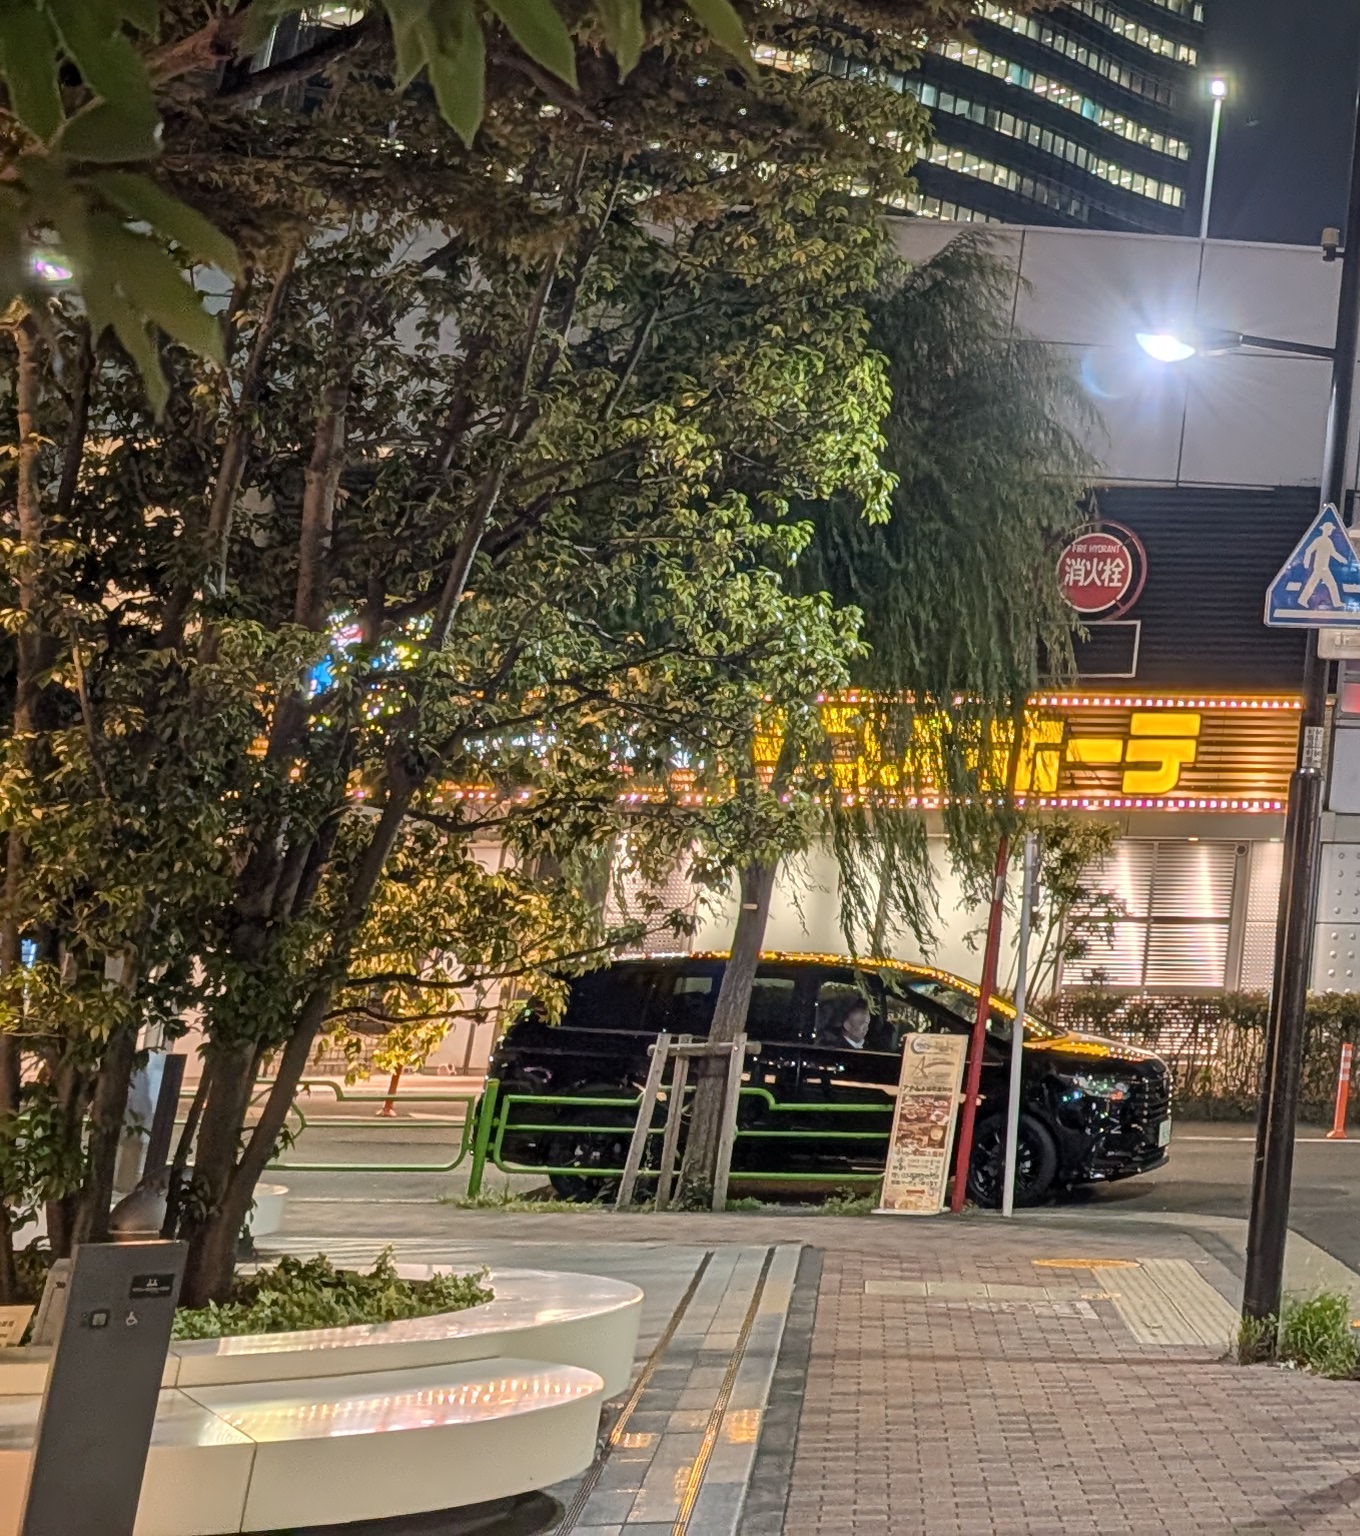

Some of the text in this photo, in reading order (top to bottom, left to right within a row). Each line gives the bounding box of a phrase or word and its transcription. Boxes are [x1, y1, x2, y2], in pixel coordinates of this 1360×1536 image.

[1071, 544, 1120, 554] FIRE HYDRANT
[1064, 557, 1126, 587] 消火栓
